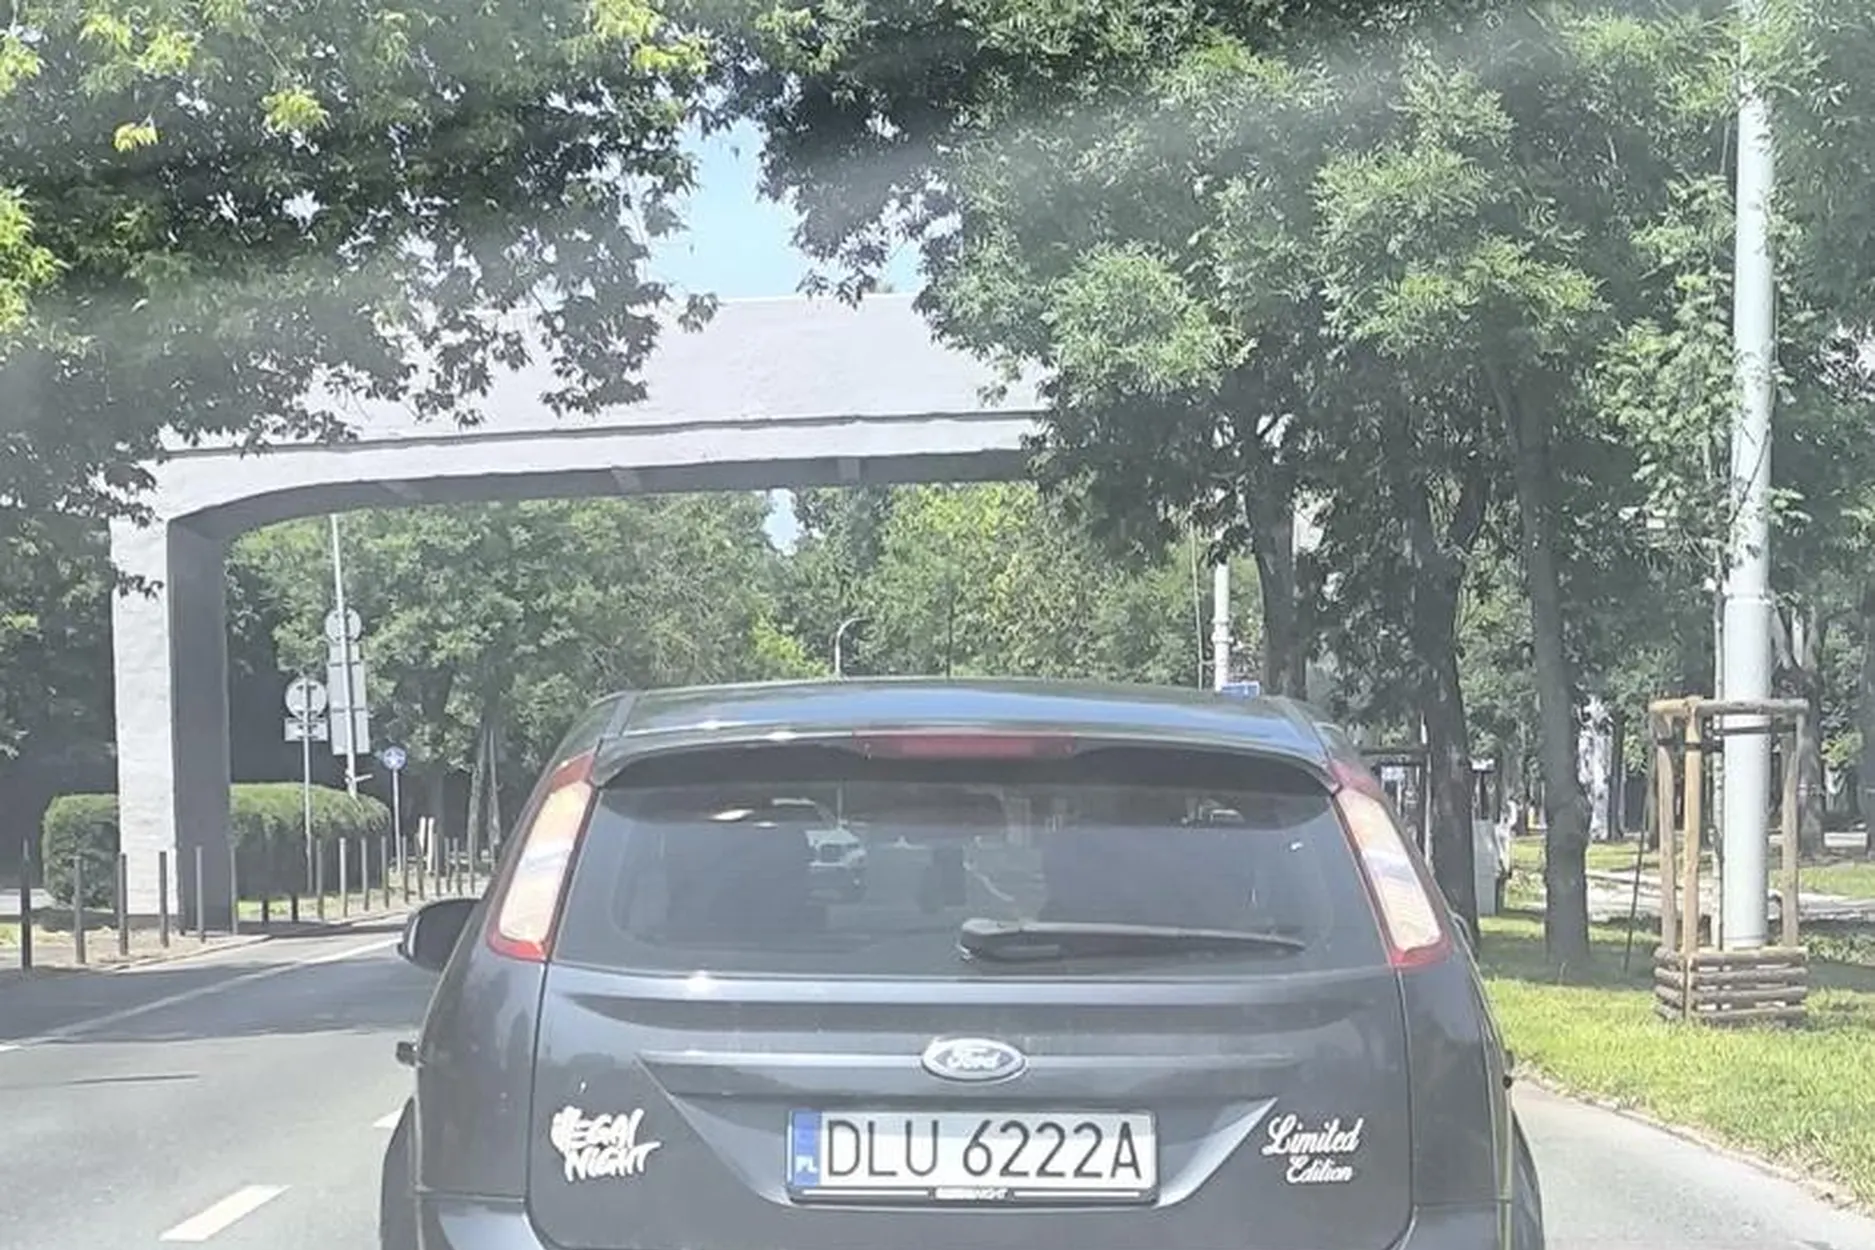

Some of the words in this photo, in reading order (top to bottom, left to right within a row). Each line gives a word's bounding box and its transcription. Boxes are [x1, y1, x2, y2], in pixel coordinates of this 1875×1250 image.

[945, 1044, 1002, 1072] Ford
[1262, 1113, 1364, 1155] Limited
[827, 1119, 940, 1178] DLU
[962, 1119, 1142, 1179] 6222A
[796, 1155, 818, 1173] PL
[1286, 1155, 1353, 1183] Edition
